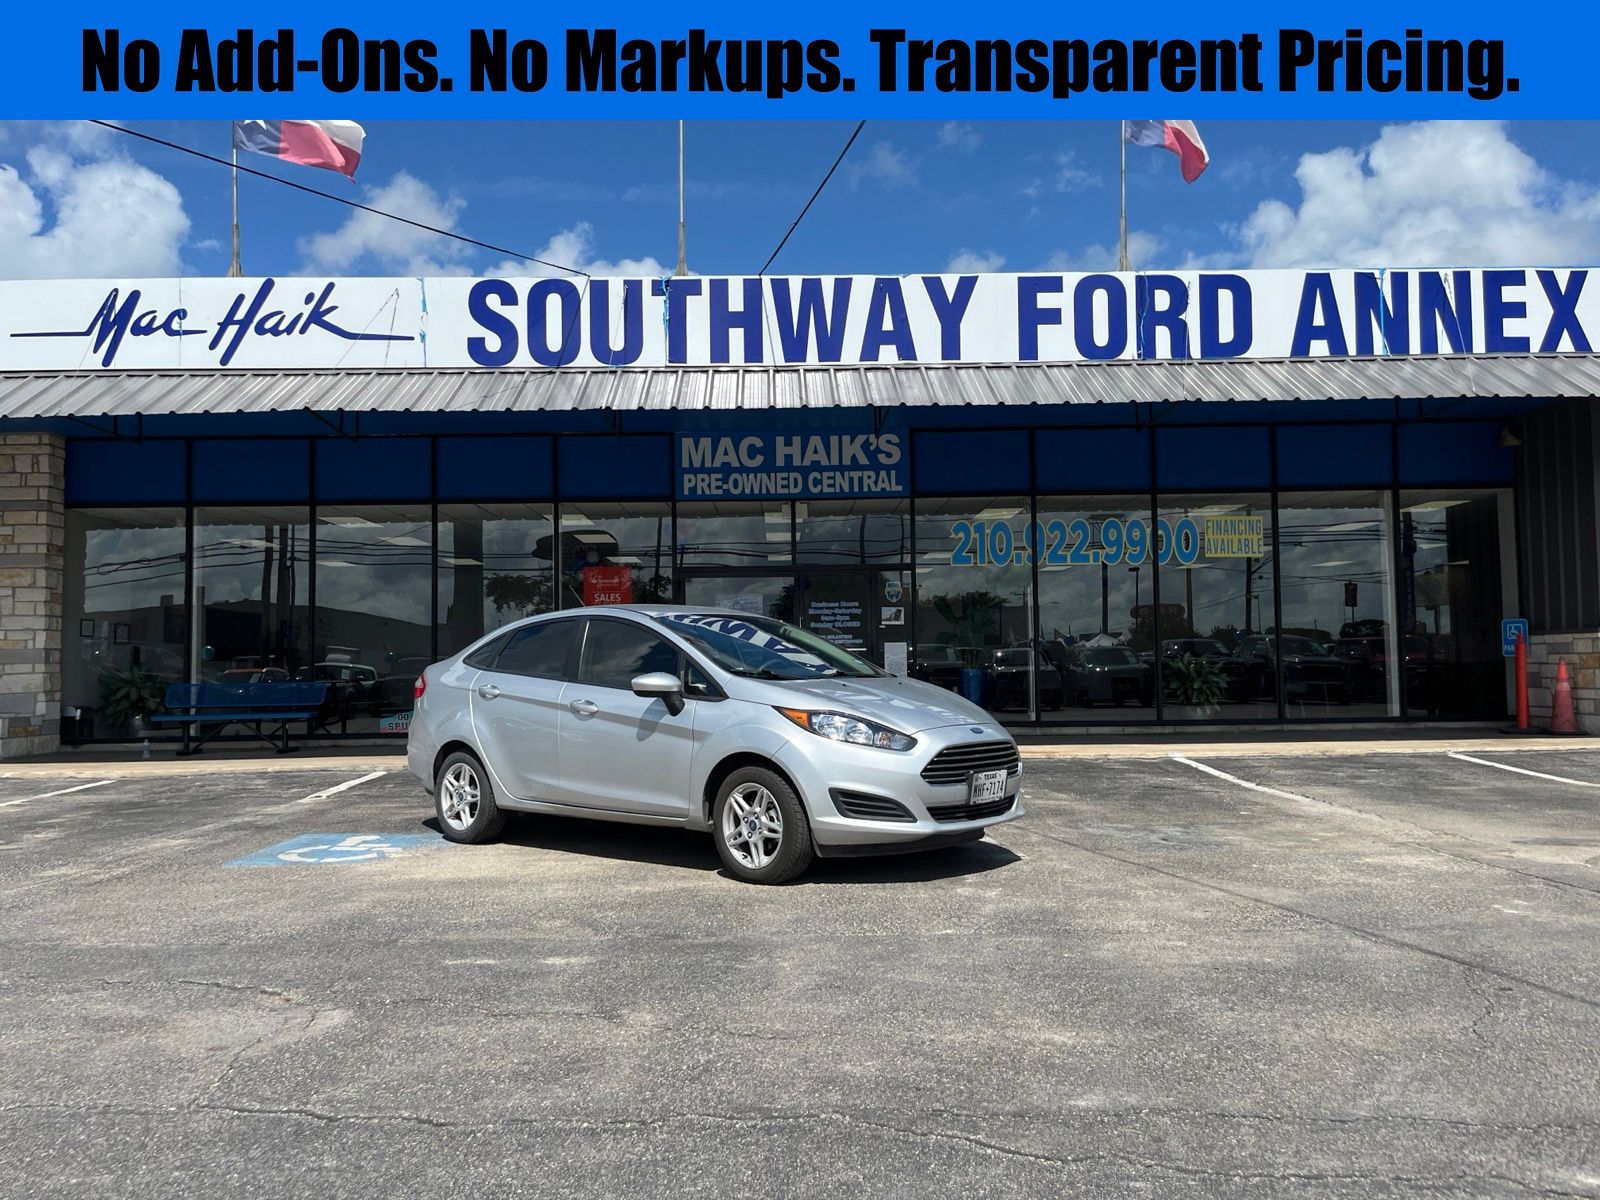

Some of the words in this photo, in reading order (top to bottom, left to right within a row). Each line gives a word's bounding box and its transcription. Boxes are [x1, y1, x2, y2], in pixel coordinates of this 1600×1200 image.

[10, 287, 207, 367] Mac
[208, 277, 414, 366] Haik
[467, 275, 980, 368] SOUTHWAY
[1016, 273, 1254, 362] FORD
[1290, 269, 1593, 358] ANNEX
[681, 436, 765, 468] MAC
[775, 433, 902, 467] HAIK'S
[683, 472, 803, 495] PRE-OWNED
[807, 470, 903, 493] CENTRAL
[1205, 519, 1262, 536] FINANCING
[950, 517, 1199, 567] 210.922.9900
[1206, 538, 1263, 554] AVAILABLE
[594, 593, 622, 602] SALES
[397, 713, 409, 721] GO
[388, 722, 411, 731] SPU
